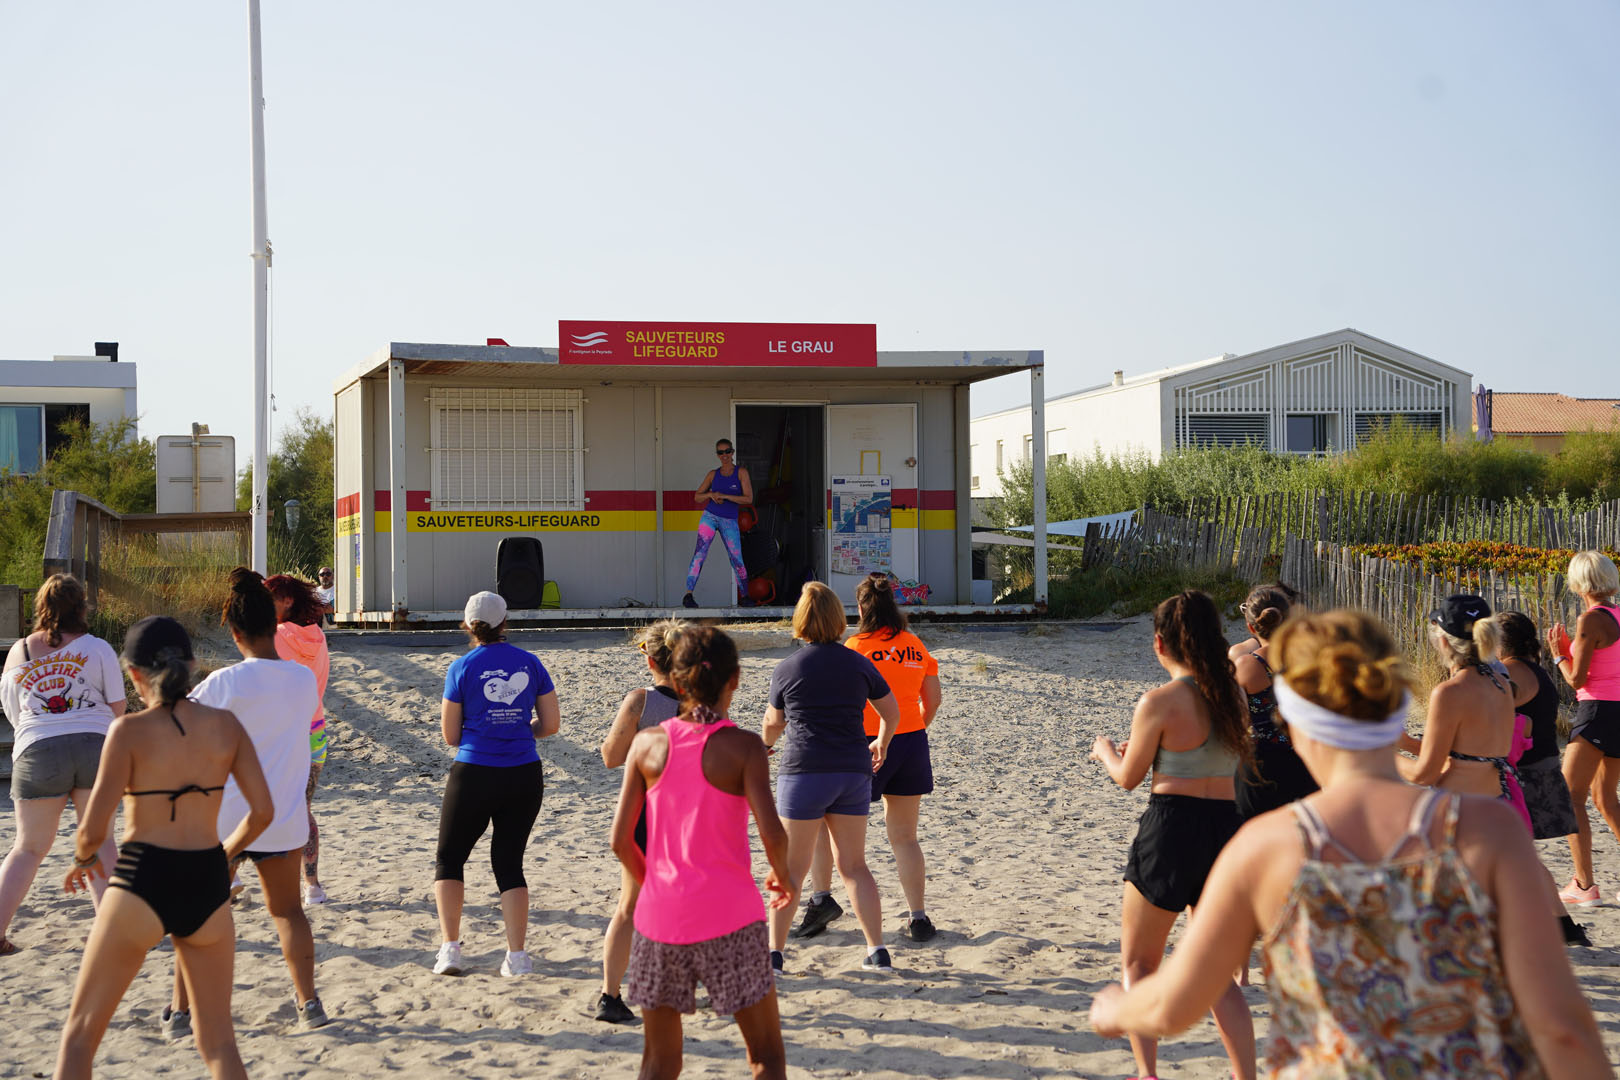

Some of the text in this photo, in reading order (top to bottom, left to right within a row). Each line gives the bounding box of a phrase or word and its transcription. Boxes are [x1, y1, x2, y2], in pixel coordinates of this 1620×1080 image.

[625, 330, 725, 344] SAUVETEURS
[633, 345, 718, 358] LIFEGUARD
[768, 340, 834, 353] LE GRAU
[416, 515, 600, 528] SAUVETEURS-LIFEGUARD
[872, 646, 923, 664] axylis
[22, 663, 82, 691] HELLFIRE
[37, 677, 66, 692] CLUB
